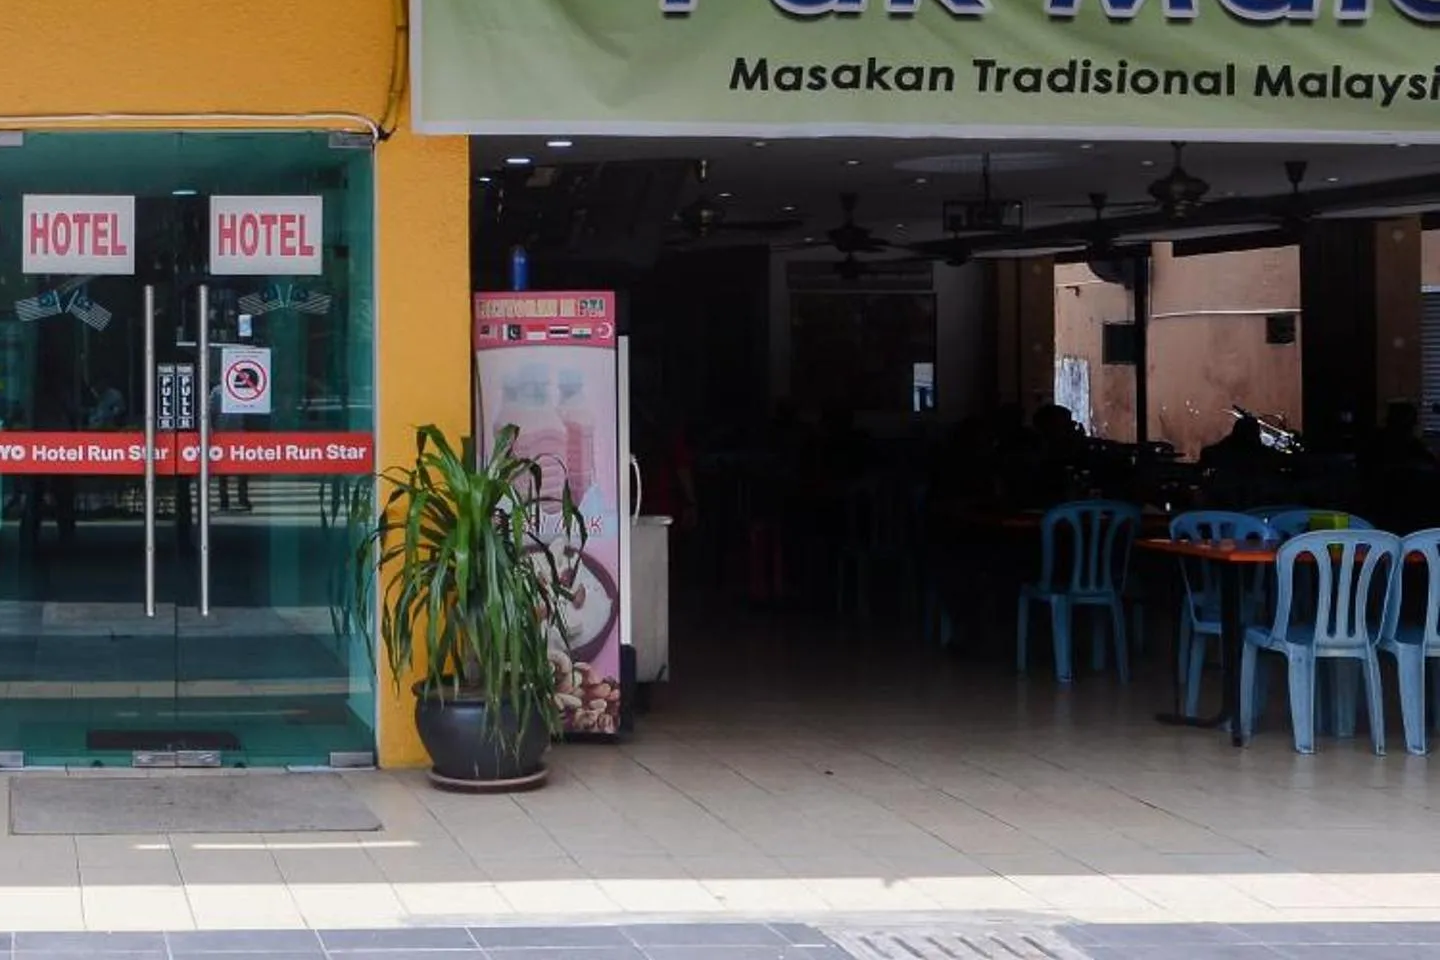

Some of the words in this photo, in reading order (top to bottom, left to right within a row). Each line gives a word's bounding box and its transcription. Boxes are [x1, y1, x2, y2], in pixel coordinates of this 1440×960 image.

[729, 56, 955, 92] Masakan
[973, 59, 1235, 96] Tradisional
[1254, 64, 1440, 107] Malaysi
[29, 212, 128, 257] HOTEL
[217, 213, 315, 257] HOTEL
[161, 376, 172, 416] PULL
[181, 376, 192, 416] PULL
[31, 445, 84, 462] Hotel
[88, 445, 125, 461] Run
[182, 446, 224, 462] OO
[230, 445, 281, 462] Hotel
[285, 445, 323, 461] Run
[326, 443, 367, 460] Star
